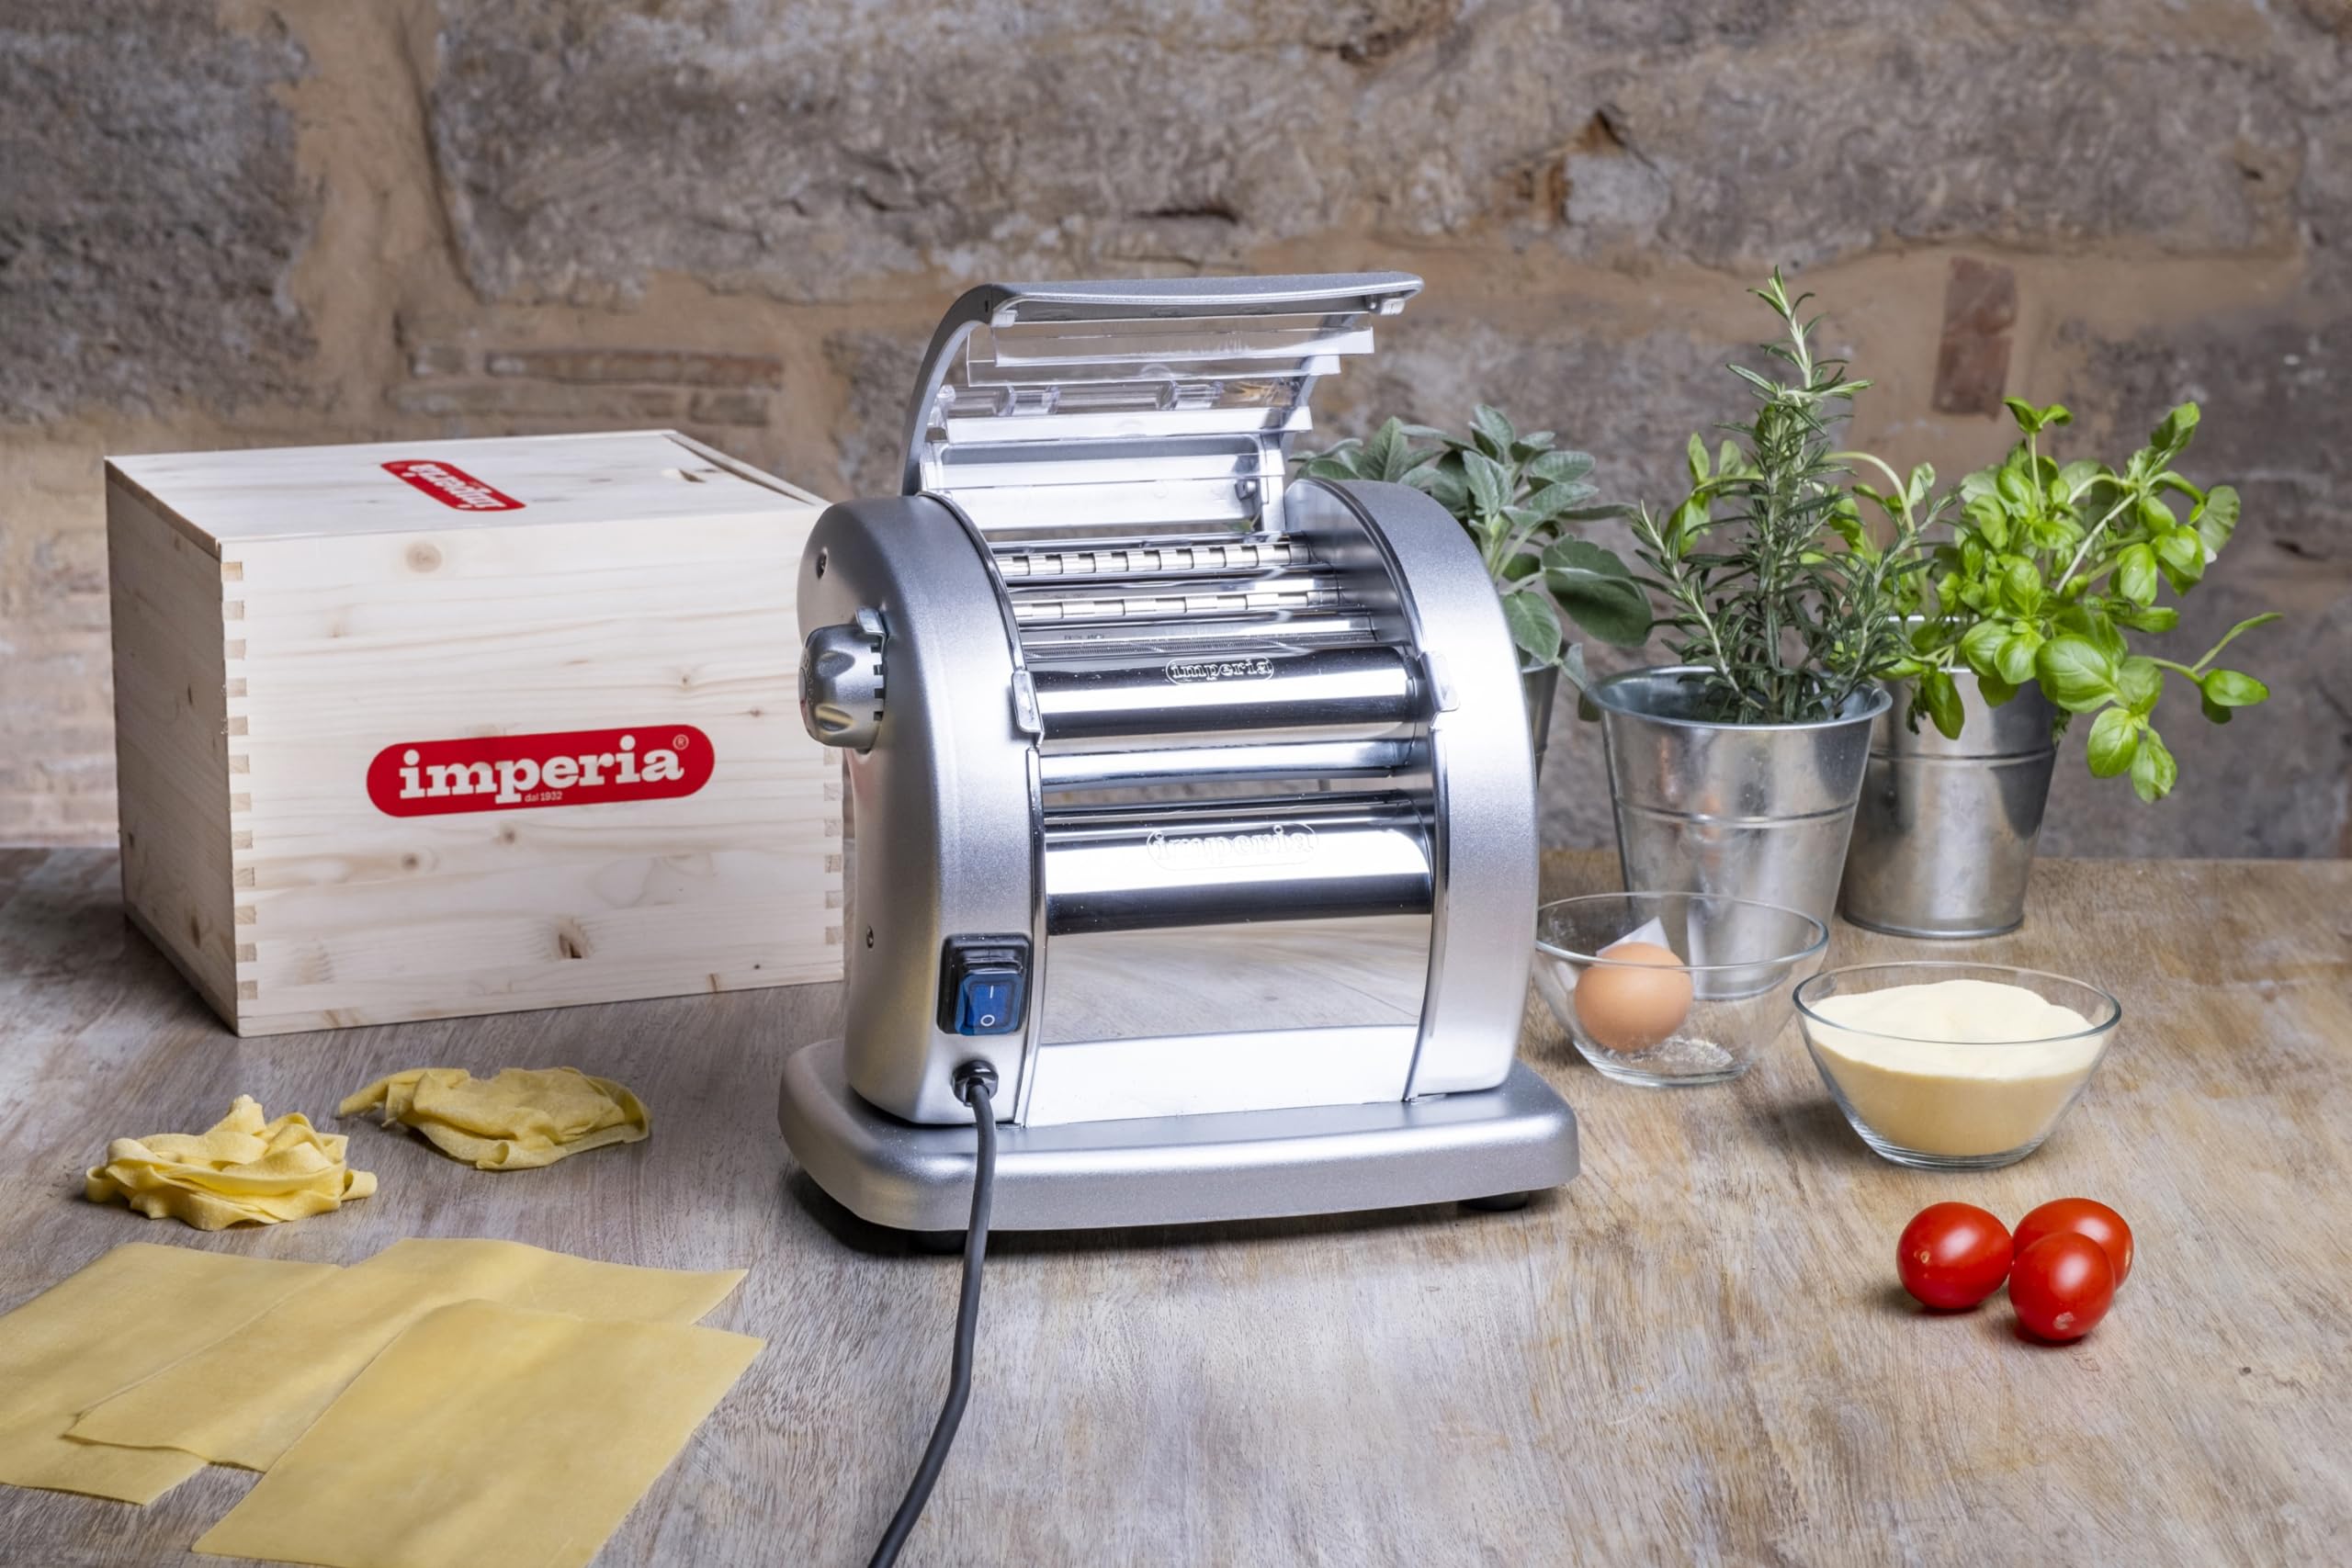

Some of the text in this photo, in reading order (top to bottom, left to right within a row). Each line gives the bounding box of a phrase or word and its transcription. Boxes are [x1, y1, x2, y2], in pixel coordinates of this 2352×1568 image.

[1170, 659, 1272, 681] imperia
[399, 735, 684, 805] imperia
[524, 791, 563, 803] dal 1932
